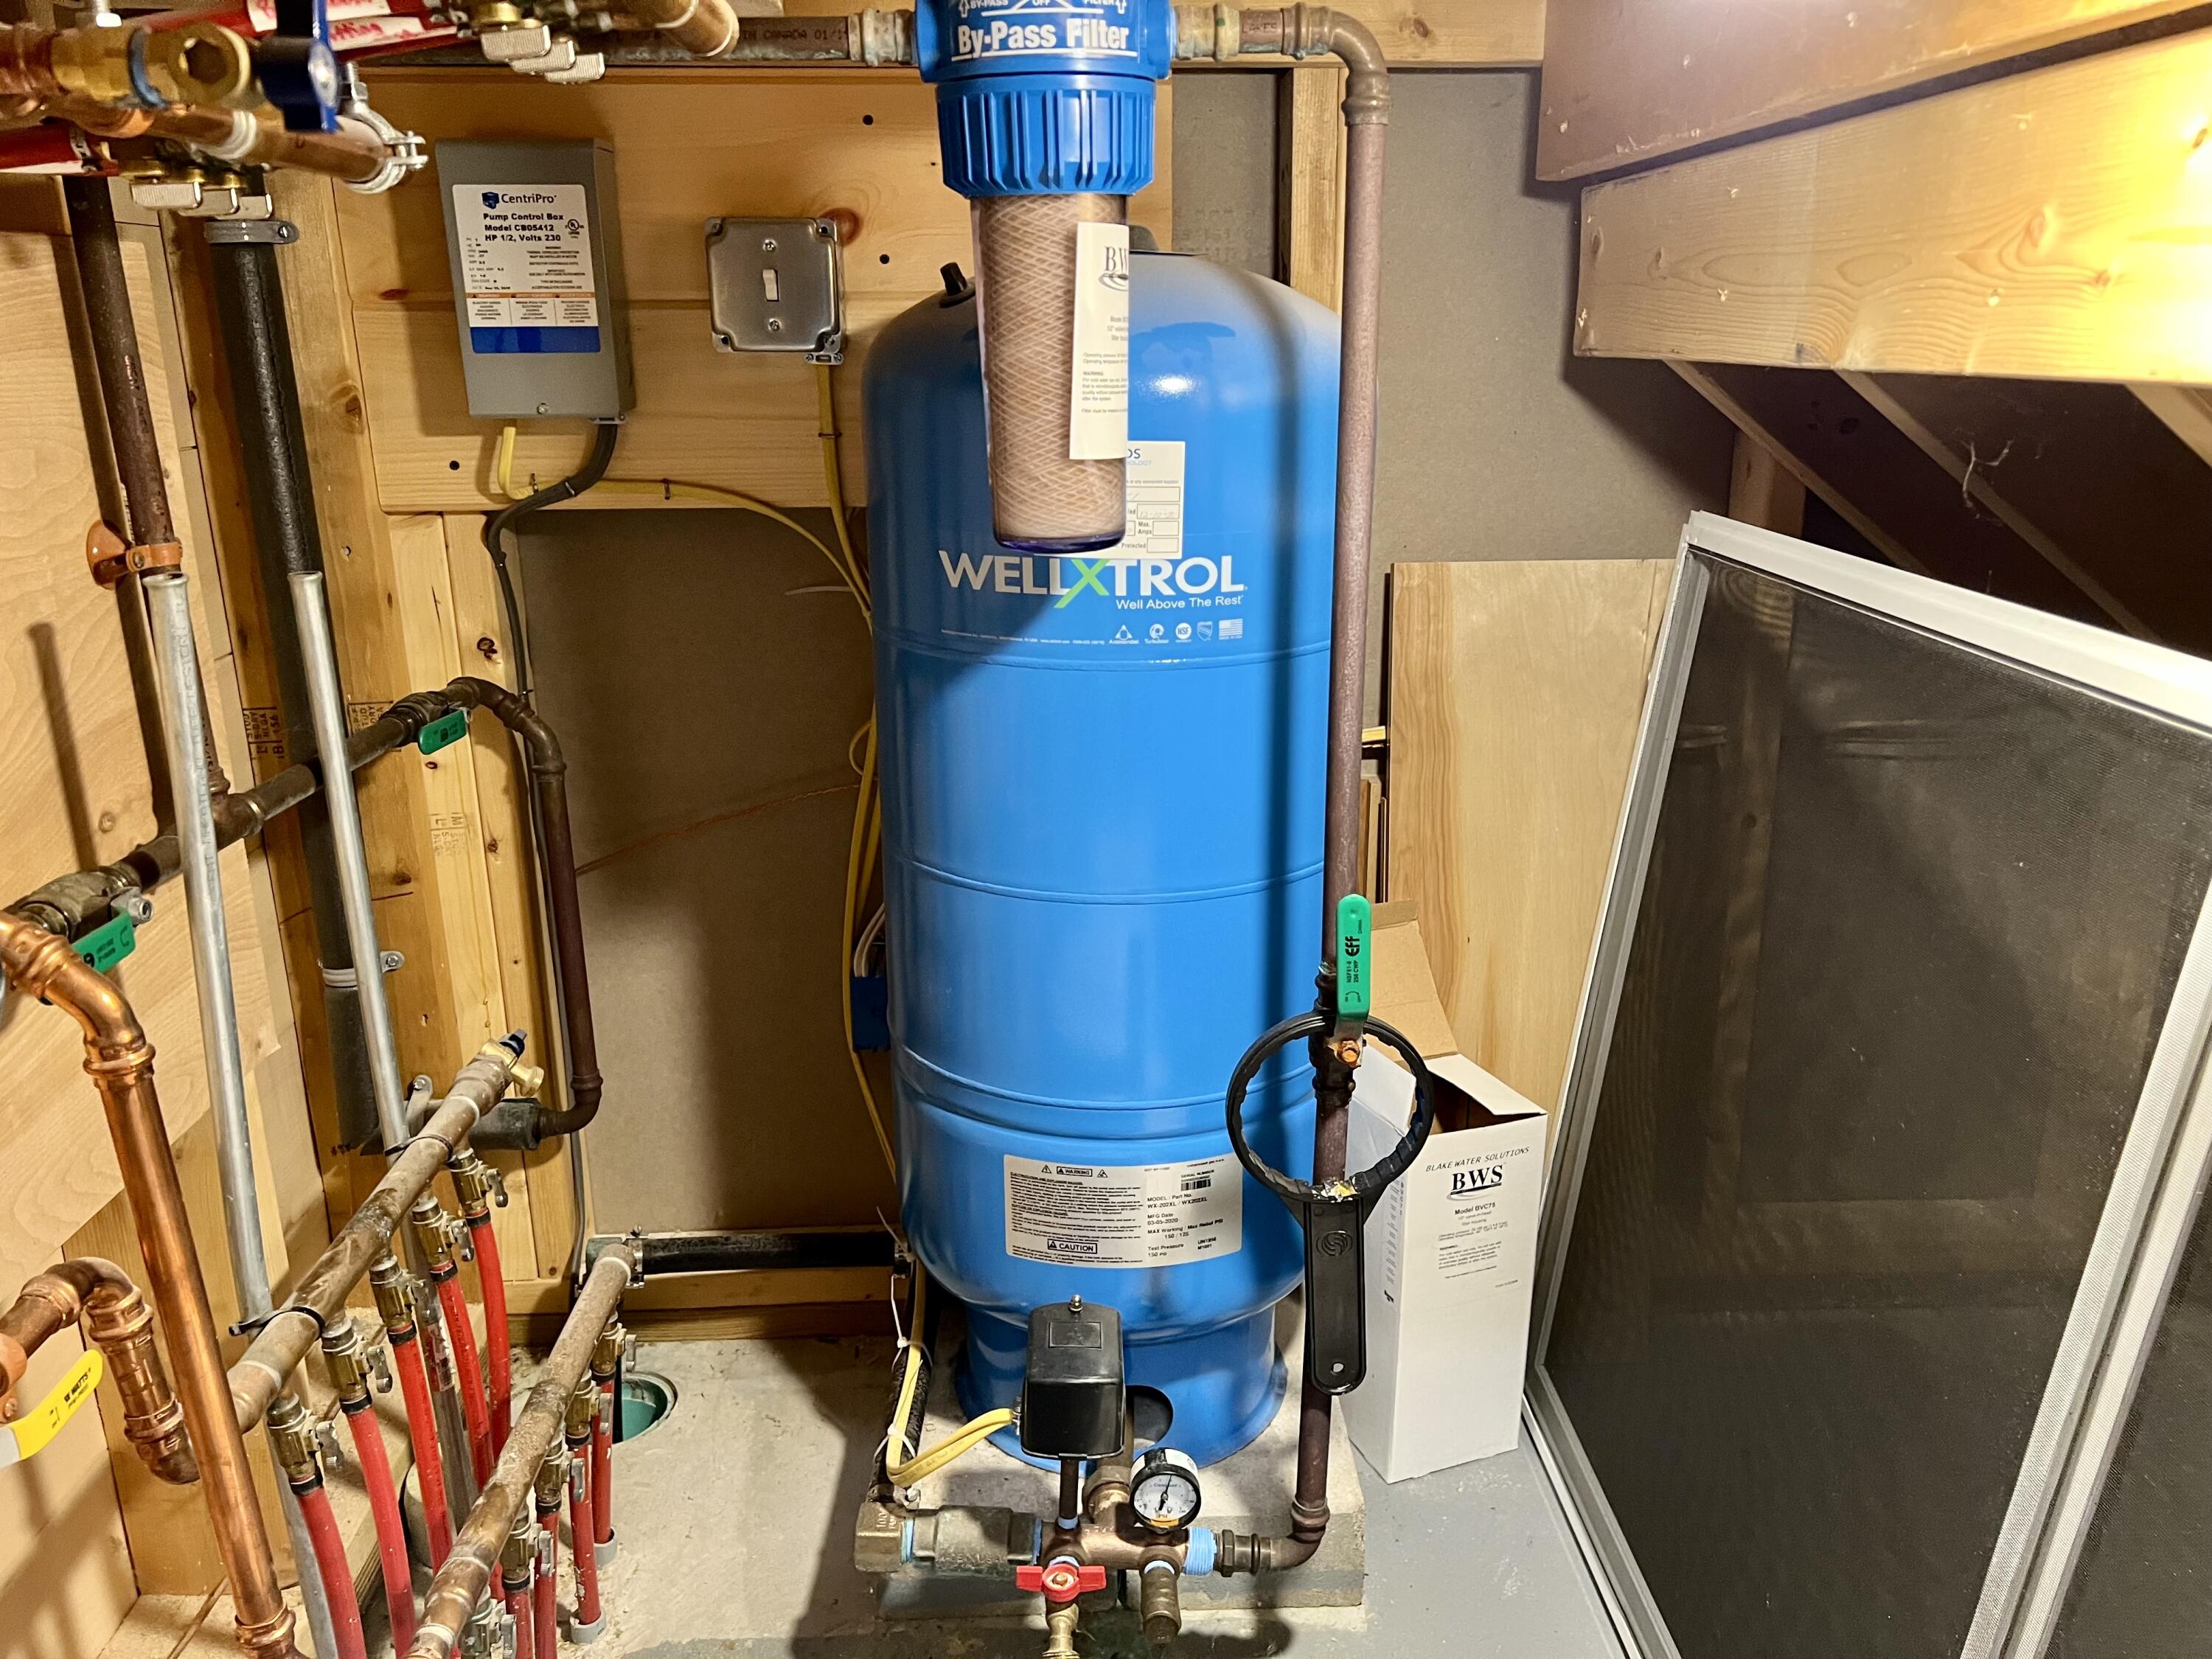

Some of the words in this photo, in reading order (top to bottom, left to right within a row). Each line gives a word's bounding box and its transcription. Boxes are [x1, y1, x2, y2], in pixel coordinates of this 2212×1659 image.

[958, 20, 1057, 58] By-Pass
[1066, 18, 1130, 49] Filter
[501, 193, 557, 204] CentriPro
[483, 213, 509, 222] Pump
[484, 234, 498, 242] HP
[518, 234, 543, 242] Volts
[1116, 599, 1144, 610] Well
[1146, 598, 1186, 610] Above
[1188, 597, 1212, 608] The
[1215, 595, 1243, 606] Rest
[1425, 1160, 1453, 1172] BLAKE
[1454, 1155, 1481, 1167] WATER
[1484, 1146, 1530, 1162] SOLUTIONS
[1451, 1164, 1503, 1192] BWS
[1454, 1206, 1474, 1215] Model
[1475, 1202, 1496, 1211] BVC75
[1059, 1242, 1094, 1252] CAUTION
